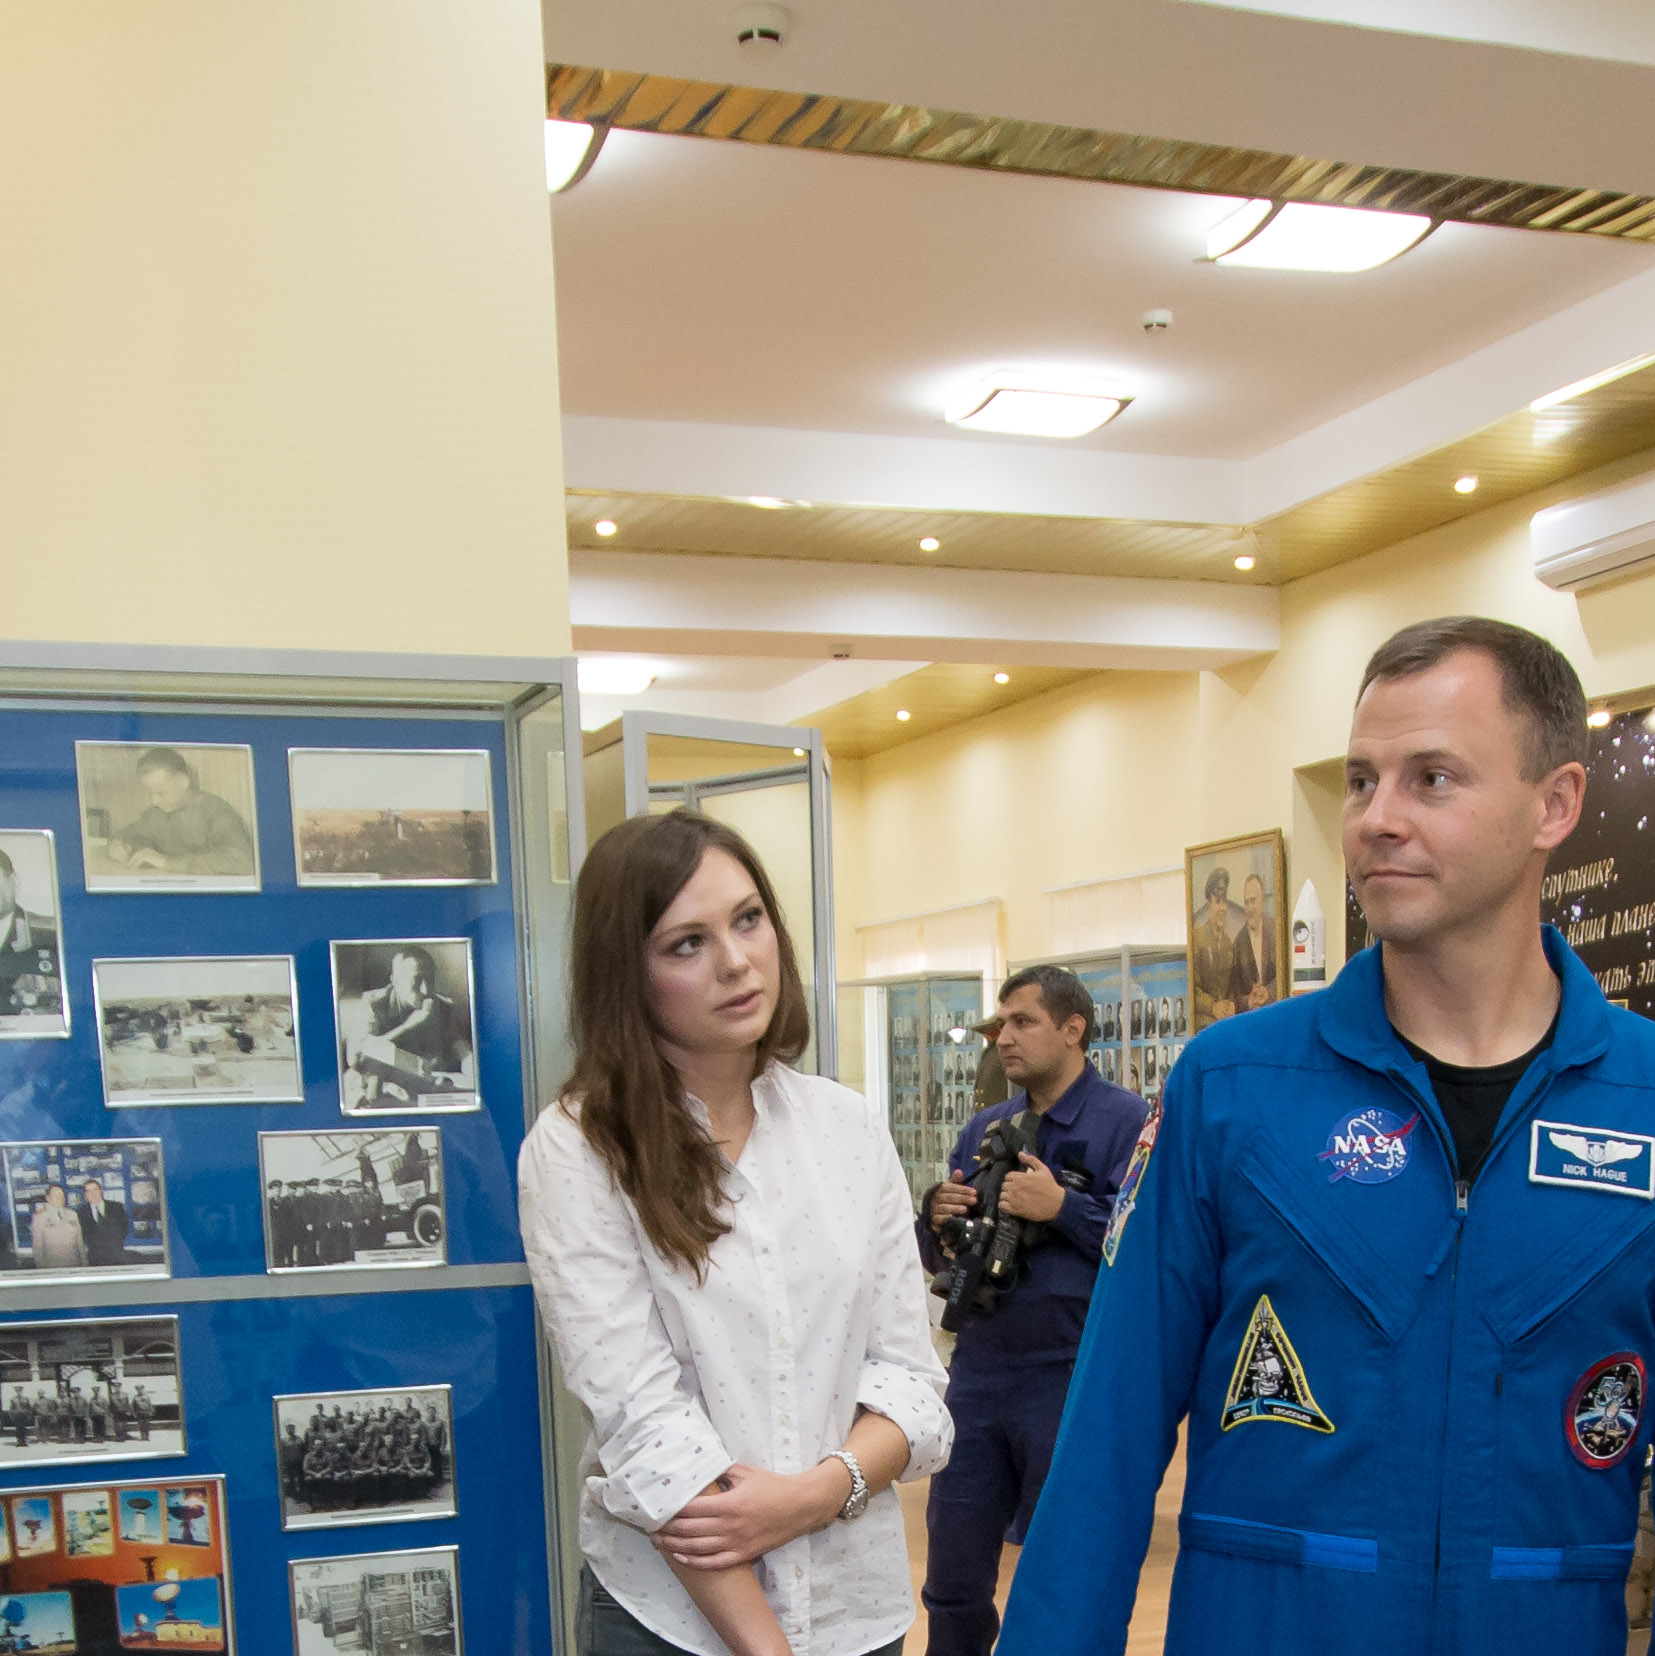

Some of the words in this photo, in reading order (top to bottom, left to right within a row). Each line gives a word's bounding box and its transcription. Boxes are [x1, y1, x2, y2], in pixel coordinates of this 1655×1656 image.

[1567, 914, 1607, 947] наша
[1334, 1135, 1407, 1156] NASA
[1562, 1163, 1588, 1177] NICK
[1592, 1167, 1628, 1182] HAGUE
